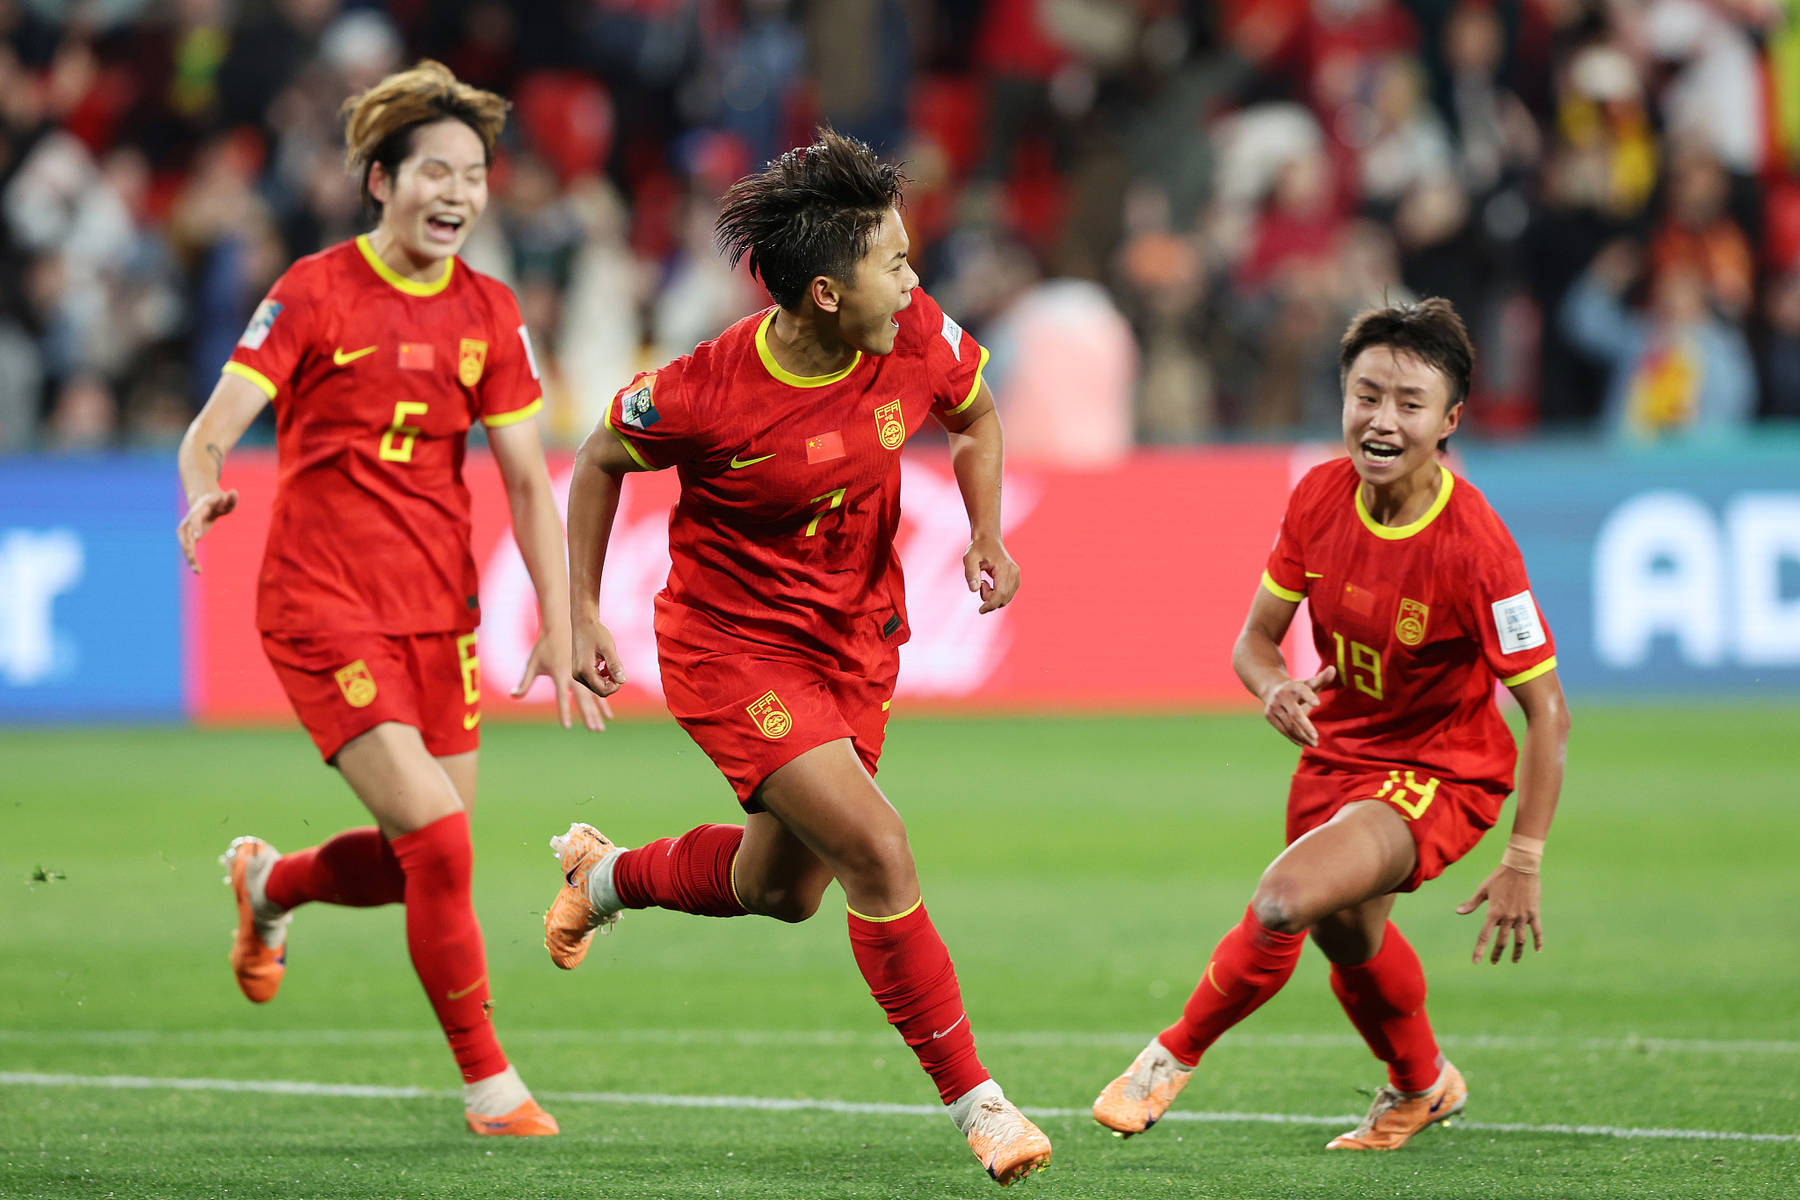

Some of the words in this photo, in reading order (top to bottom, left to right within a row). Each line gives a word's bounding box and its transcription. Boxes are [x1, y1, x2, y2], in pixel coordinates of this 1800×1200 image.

[379, 401, 428, 462] 6
[877, 403, 899, 420] CFA
[806, 488, 847, 537] 7
[1332, 631, 1383, 700] 19
[750, 694, 776, 716] CFA
